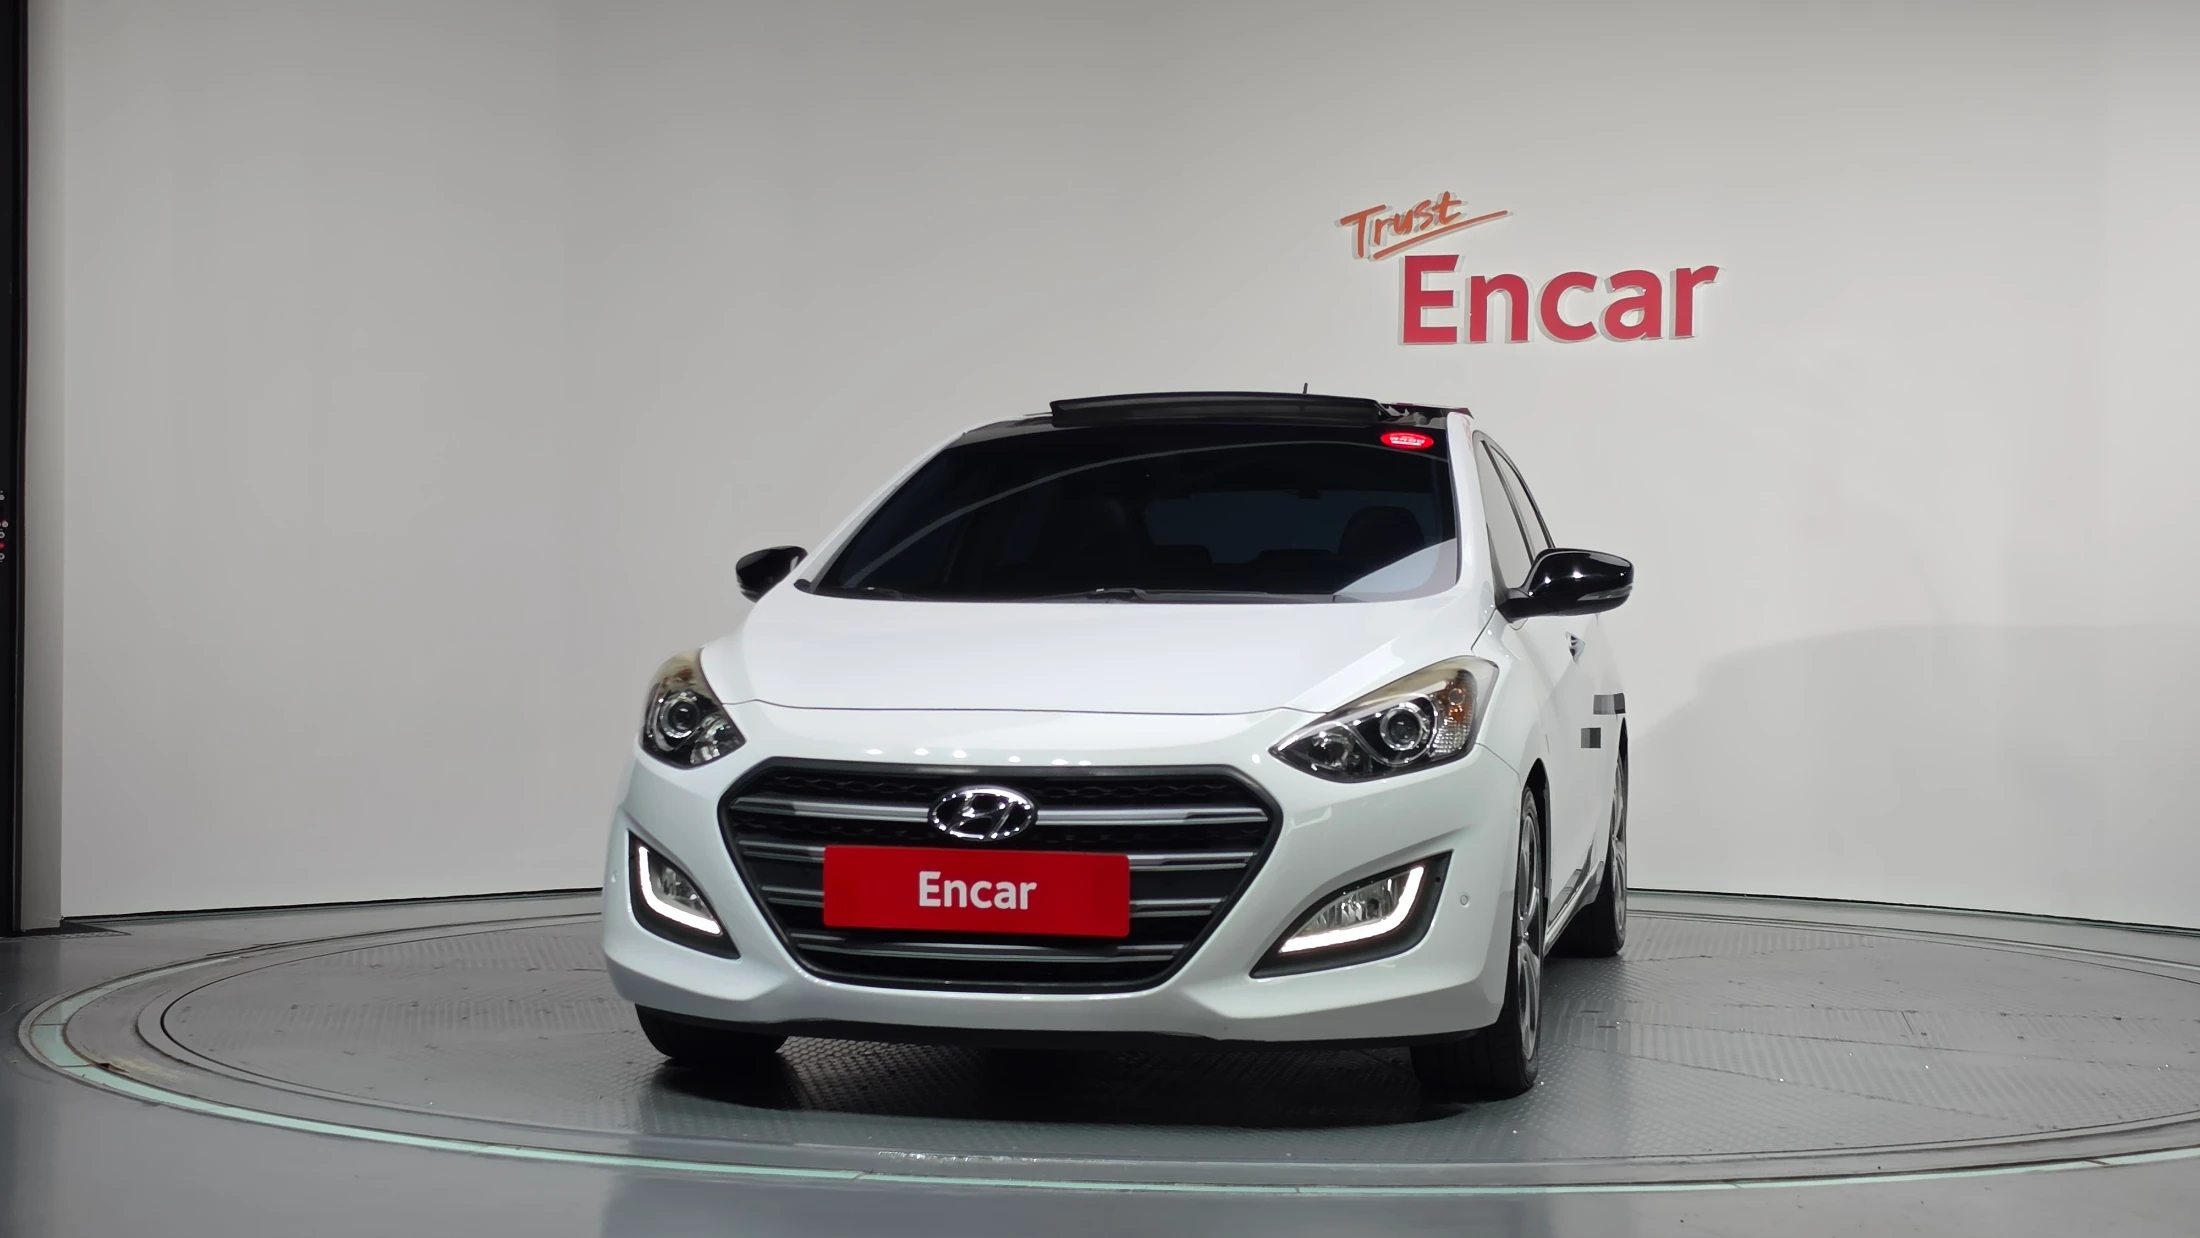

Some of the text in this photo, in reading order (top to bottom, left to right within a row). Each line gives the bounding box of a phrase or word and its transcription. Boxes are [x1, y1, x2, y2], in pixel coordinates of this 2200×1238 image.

[1340, 190, 1463, 258] Trust
[1402, 254, 1720, 344] Encar
[918, 870, 1038, 910] Encar
